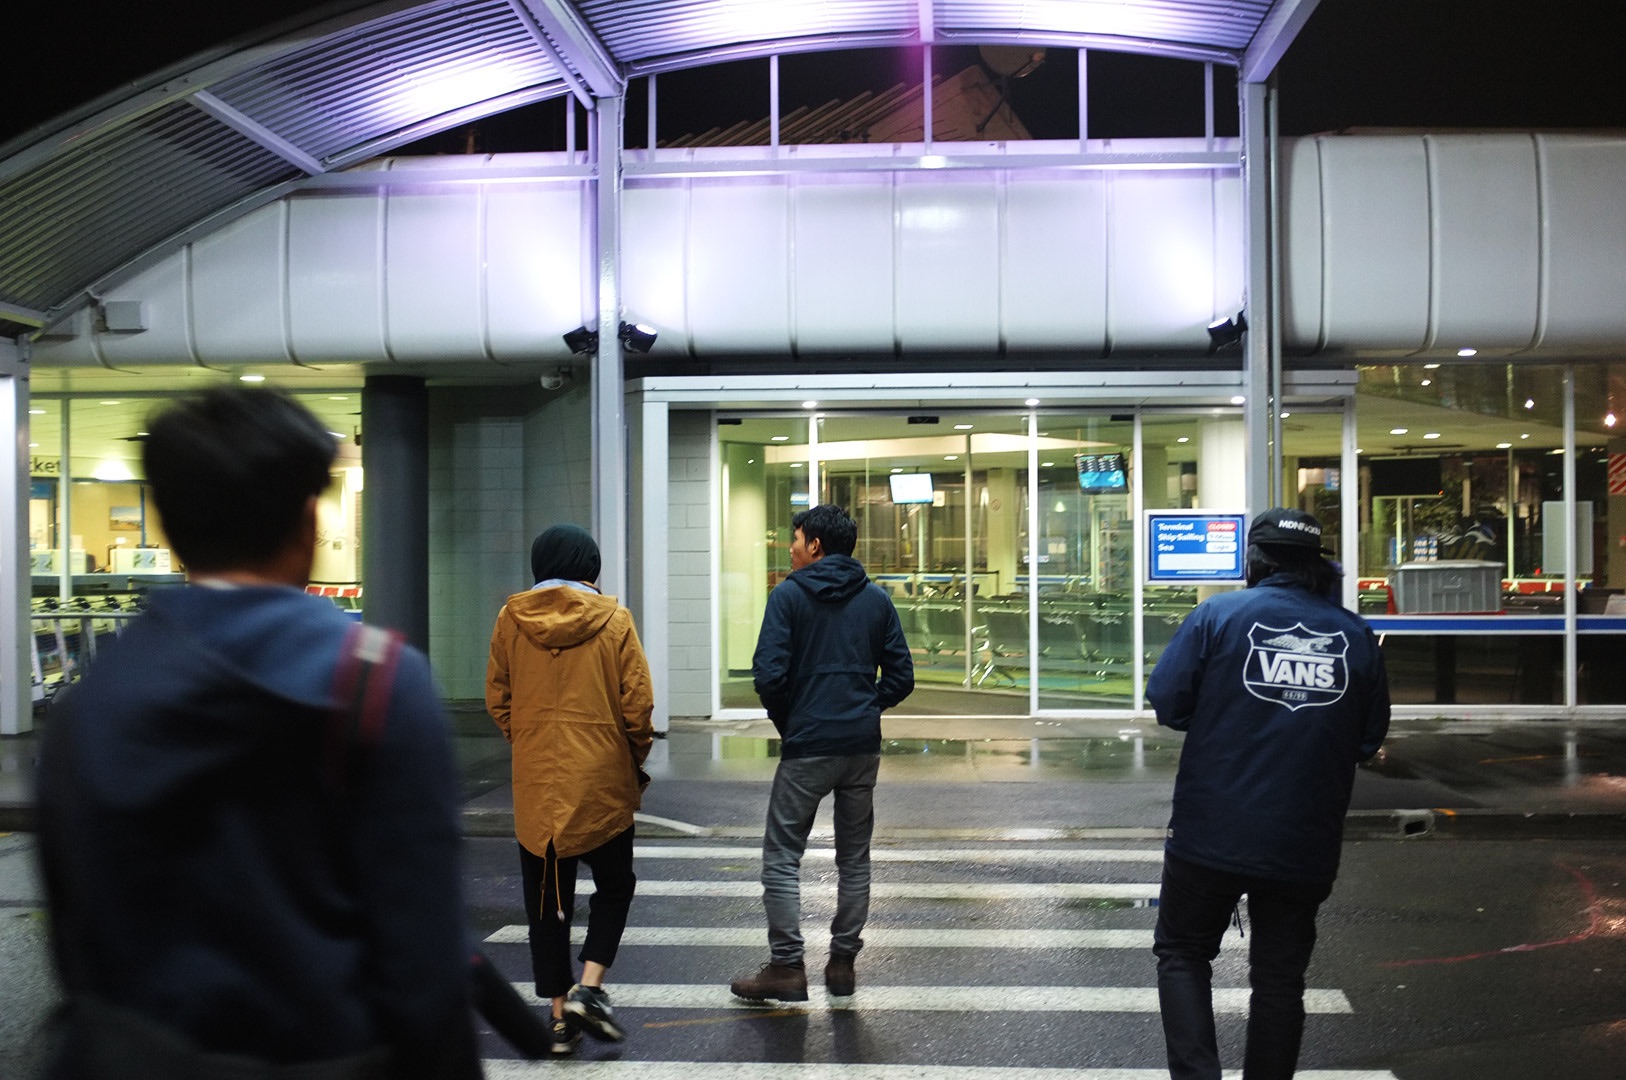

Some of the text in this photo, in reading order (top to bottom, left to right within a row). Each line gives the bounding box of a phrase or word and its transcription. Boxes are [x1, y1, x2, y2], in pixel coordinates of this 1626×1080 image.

[1157, 522, 1194, 532] Terminal
[1177, 532, 1205, 543] Sailing
[1258, 650, 1335, 689] VANS
